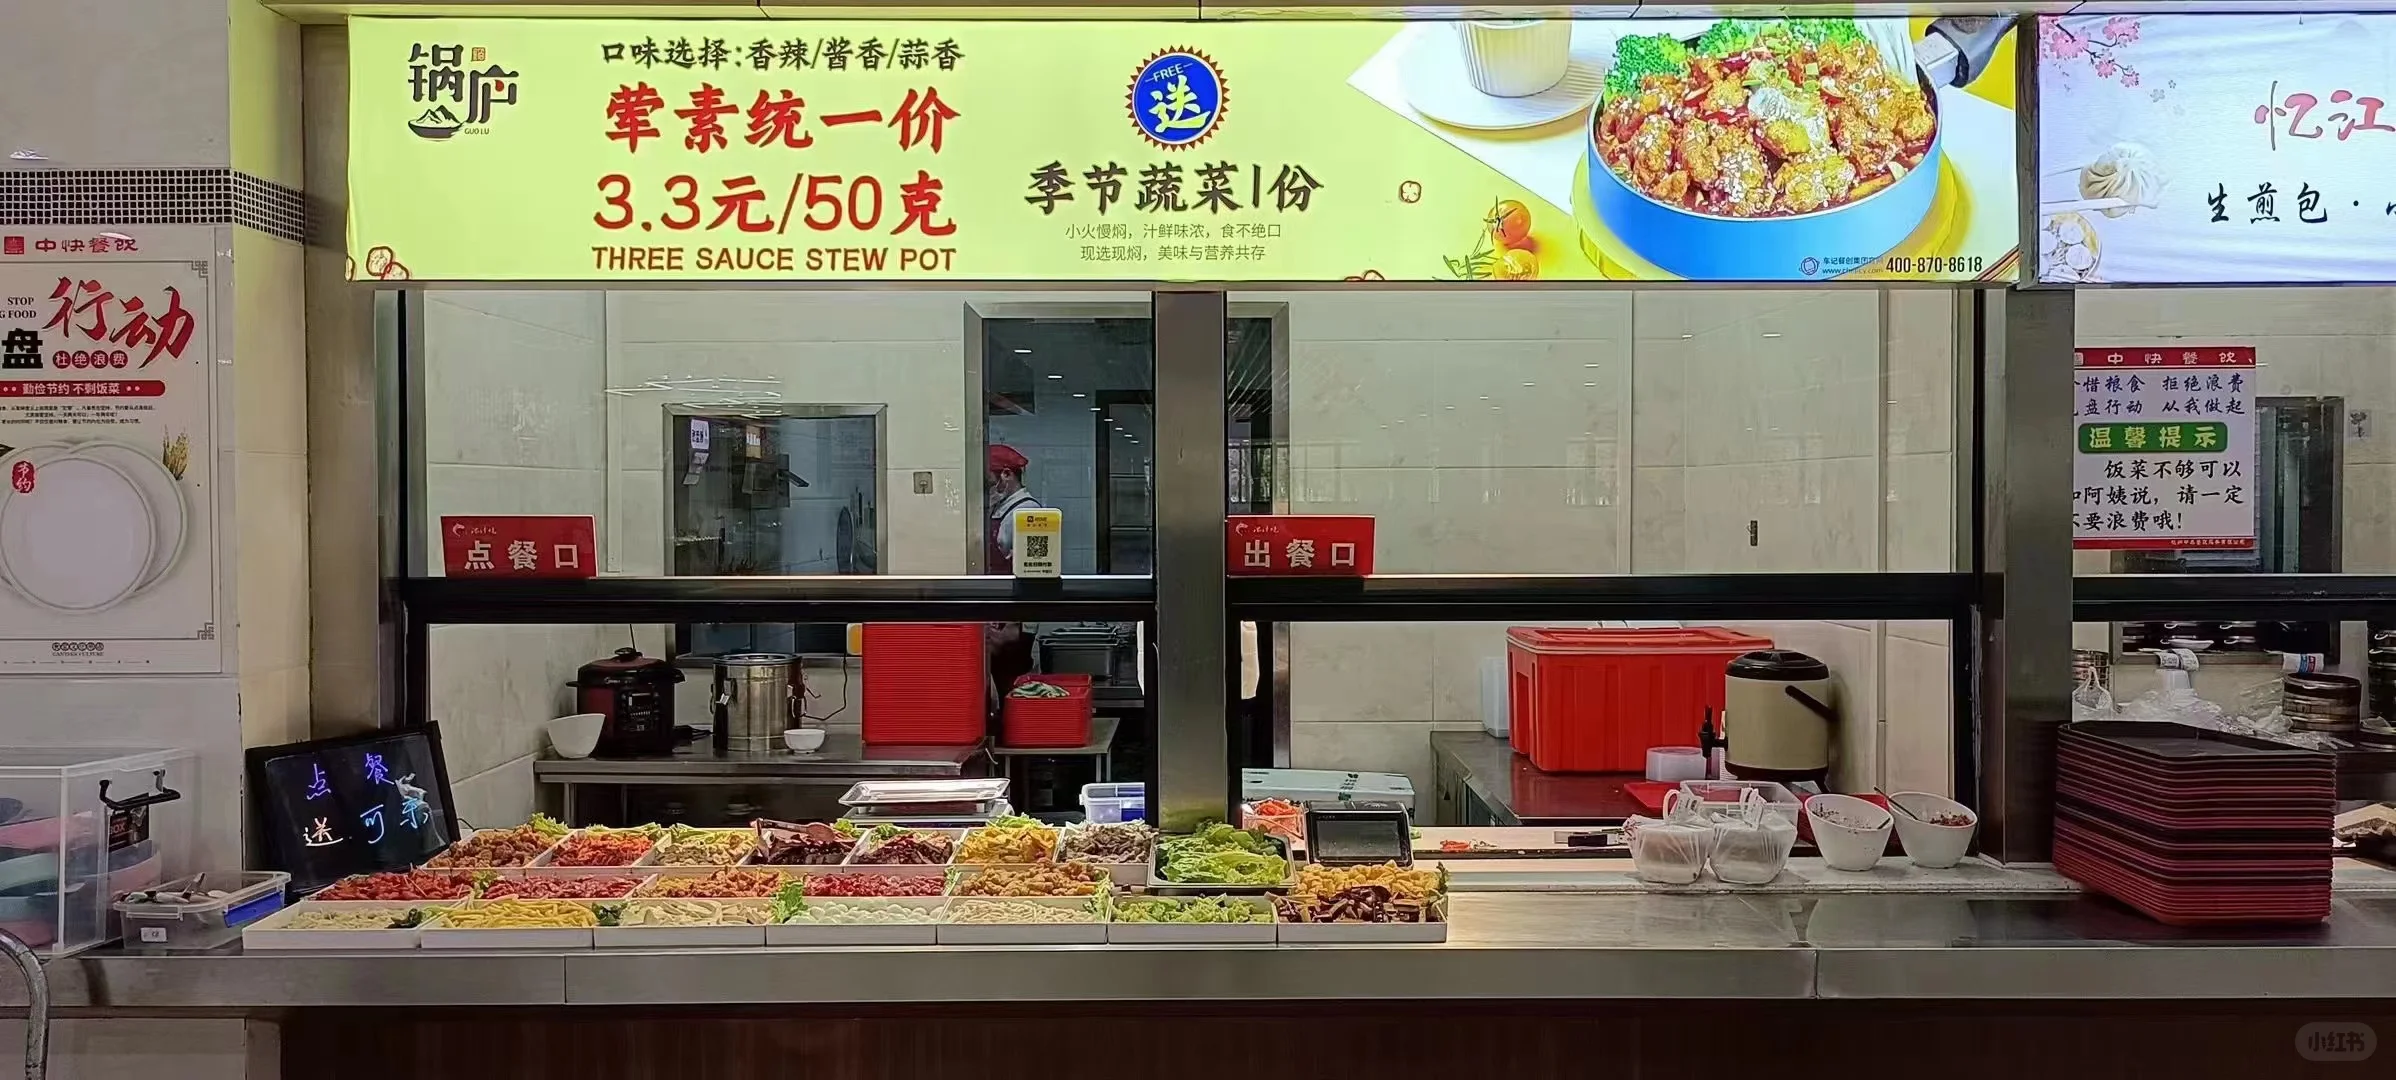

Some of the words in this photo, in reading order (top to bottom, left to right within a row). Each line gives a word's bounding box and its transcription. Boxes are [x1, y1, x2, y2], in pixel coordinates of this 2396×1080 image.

[1153, 63, 1185, 83] FREE
[1149, 75, 1211, 134] 送
[2254, 80, 2396, 151] 忆江
[604, 81, 961, 154] 荤素统一价
[593, 170, 958, 237] 3.3元/50克
[35, 237, 139, 253] 中快餐饮
[592, 247, 684, 272] THREE
[696, 247, 795, 272] SAUCE
[806, 247, 889, 272] STEW
[900, 247, 958, 272] POT
[1886, 256, 1983, 274] 400-870-8618
[7, 297, 35, 306] STOP
[8, 310, 37, 319] FOOD
[42, 276, 195, 369] 行动
[1, 328, 43, 369] 盘
[54, 350, 128, 368] 杜绝浪费
[2107, 351, 2238, 365] 中快餐饮
[22, 382, 70, 395] 勤俭节约
[73, 382, 120, 395] 不剩饭菜
[2162, 372, 2246, 392] 拒绝浪费
[2073, 398, 2144, 417] 盘行动
[2161, 396, 2247, 416] 从我做起
[2089, 425, 2217, 449] 温馨提示
[2104, 459, 2242, 480] 饭菜不够可以
[464, 540, 579, 570] 点餐口
[1244, 538, 1355, 569] 出餐口
[307, 753, 394, 800] 点餐
